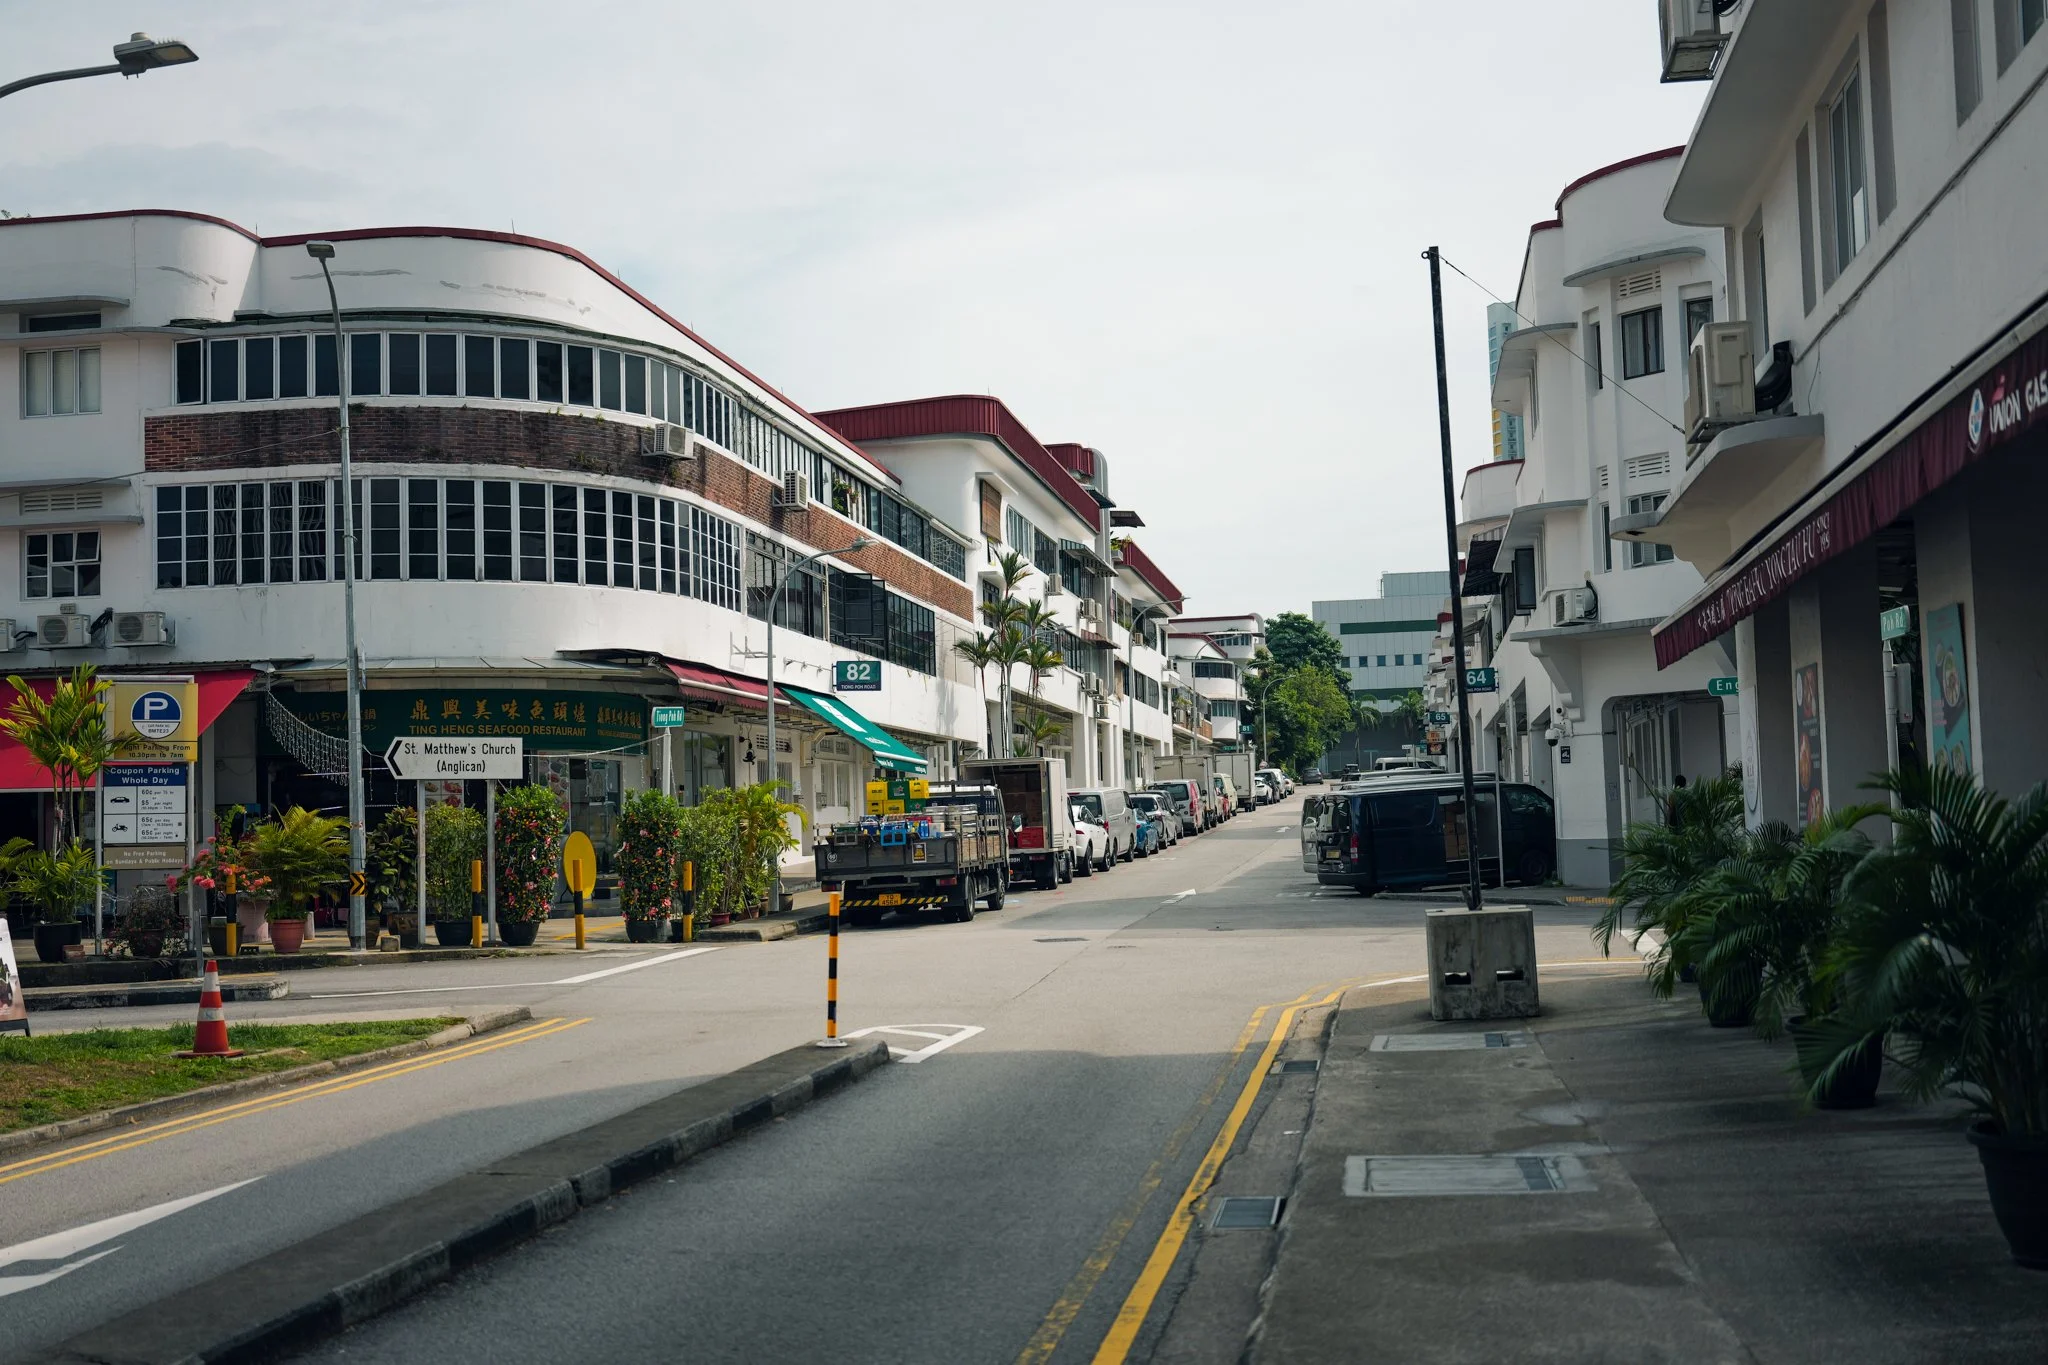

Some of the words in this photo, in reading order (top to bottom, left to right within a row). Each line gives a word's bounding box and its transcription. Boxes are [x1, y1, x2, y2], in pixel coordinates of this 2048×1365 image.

[1990, 390, 2021, 432] UNION
[2025, 370, 2048, 413] GAS
[1802, 522, 1815, 564] FU
[1882, 616, 1894, 632] Poh
[1895, 612, 1904, 628] Rd
[846, 664, 870, 680] 82
[1466, 670, 1486, 685] 64
[144, 698, 168, 720] P
[656, 710, 668, 724] Tiong
[677, 710, 682, 722] Rd
[409, 725, 437, 734] TING
[441, 725, 474, 734] HENG
[478, 725, 530, 735] SEAFOOD
[533, 726, 586, 737] RESTAURANT
[404, 743, 418, 755] St.
[425, 743, 476, 755] Matthew's
[482, 743, 516, 755] Church
[437, 760, 486, 774] (Anglican)
